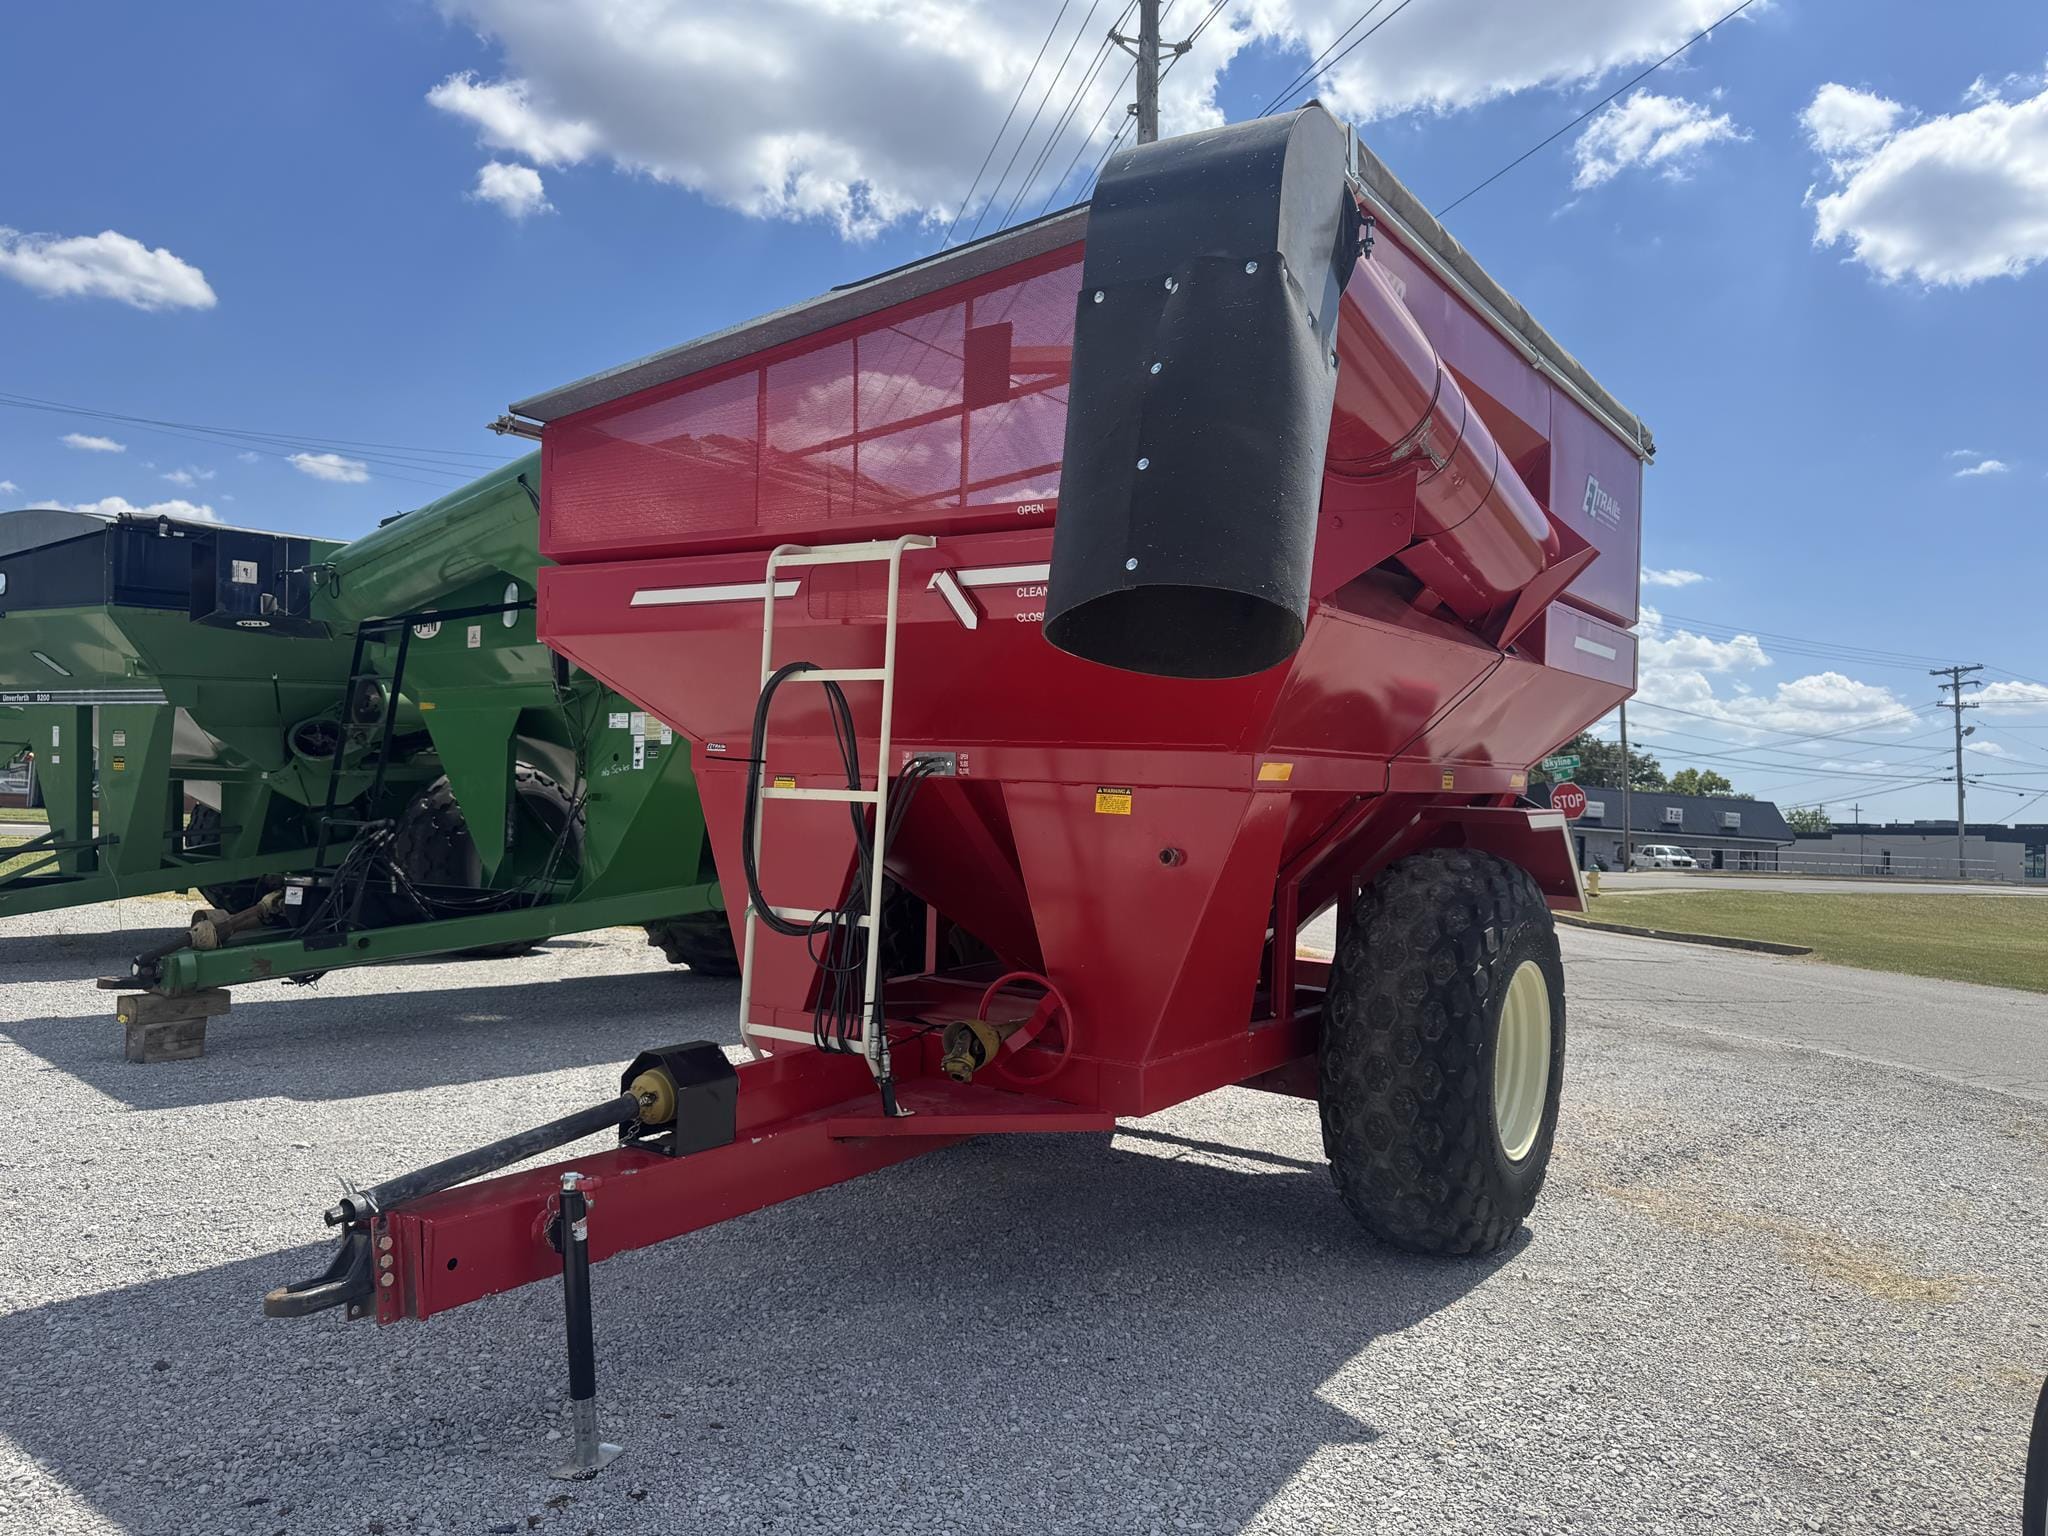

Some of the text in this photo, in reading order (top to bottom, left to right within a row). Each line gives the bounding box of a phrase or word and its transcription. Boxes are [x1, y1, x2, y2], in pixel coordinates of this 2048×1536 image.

[1017, 504, 1044, 515] OPEN
[1544, 757, 1572, 768] Skyline
[1553, 793, 1583, 808] STOP
